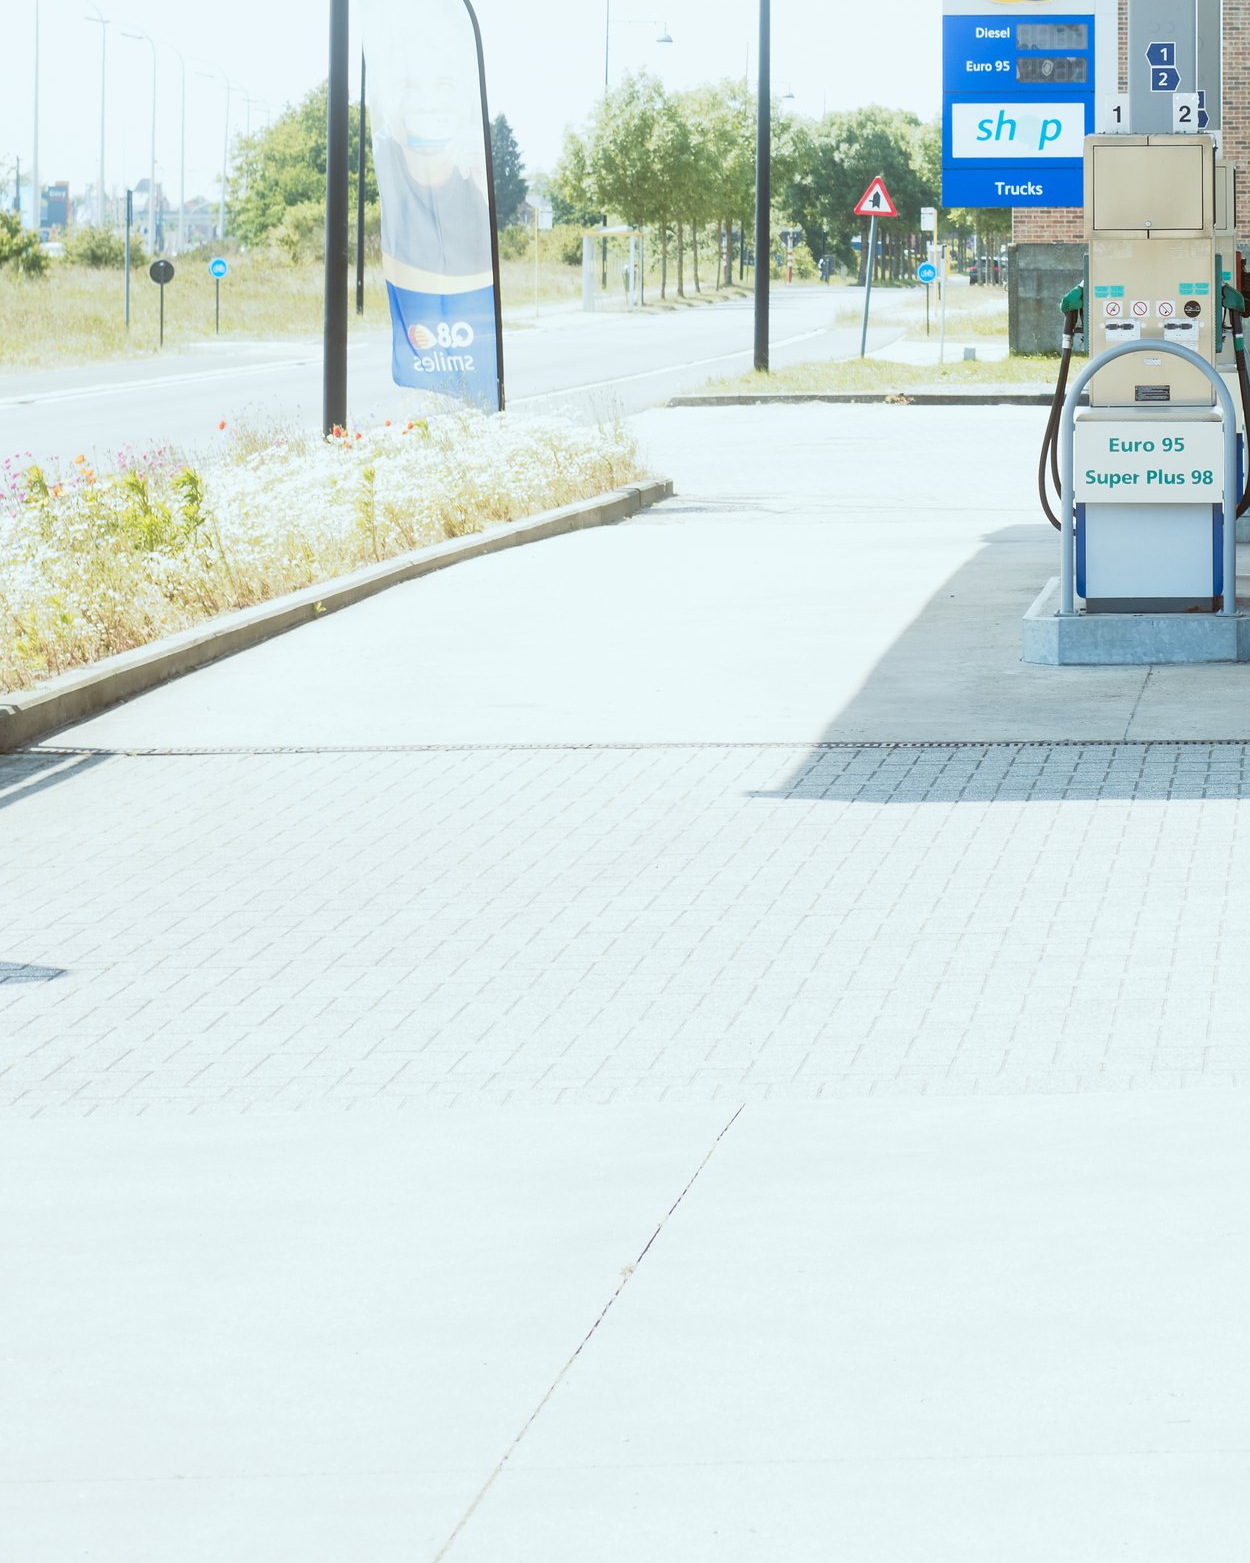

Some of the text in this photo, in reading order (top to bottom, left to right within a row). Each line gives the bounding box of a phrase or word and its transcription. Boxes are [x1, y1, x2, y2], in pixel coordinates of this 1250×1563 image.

[975, 27, 1010, 38] Diesel
[1160, 47, 1168, 61] 1
[966, 61, 1010, 72] Euro 95
[1158, 72, 1168, 86] 2
[1112, 105, 1121, 123] 1
[1178, 105, 1192, 123] 2
[994, 181, 1043, 195] Trucks
[1109, 437, 1185, 452] Euro 95
[1085, 469, 1214, 488] Super Plus 98
